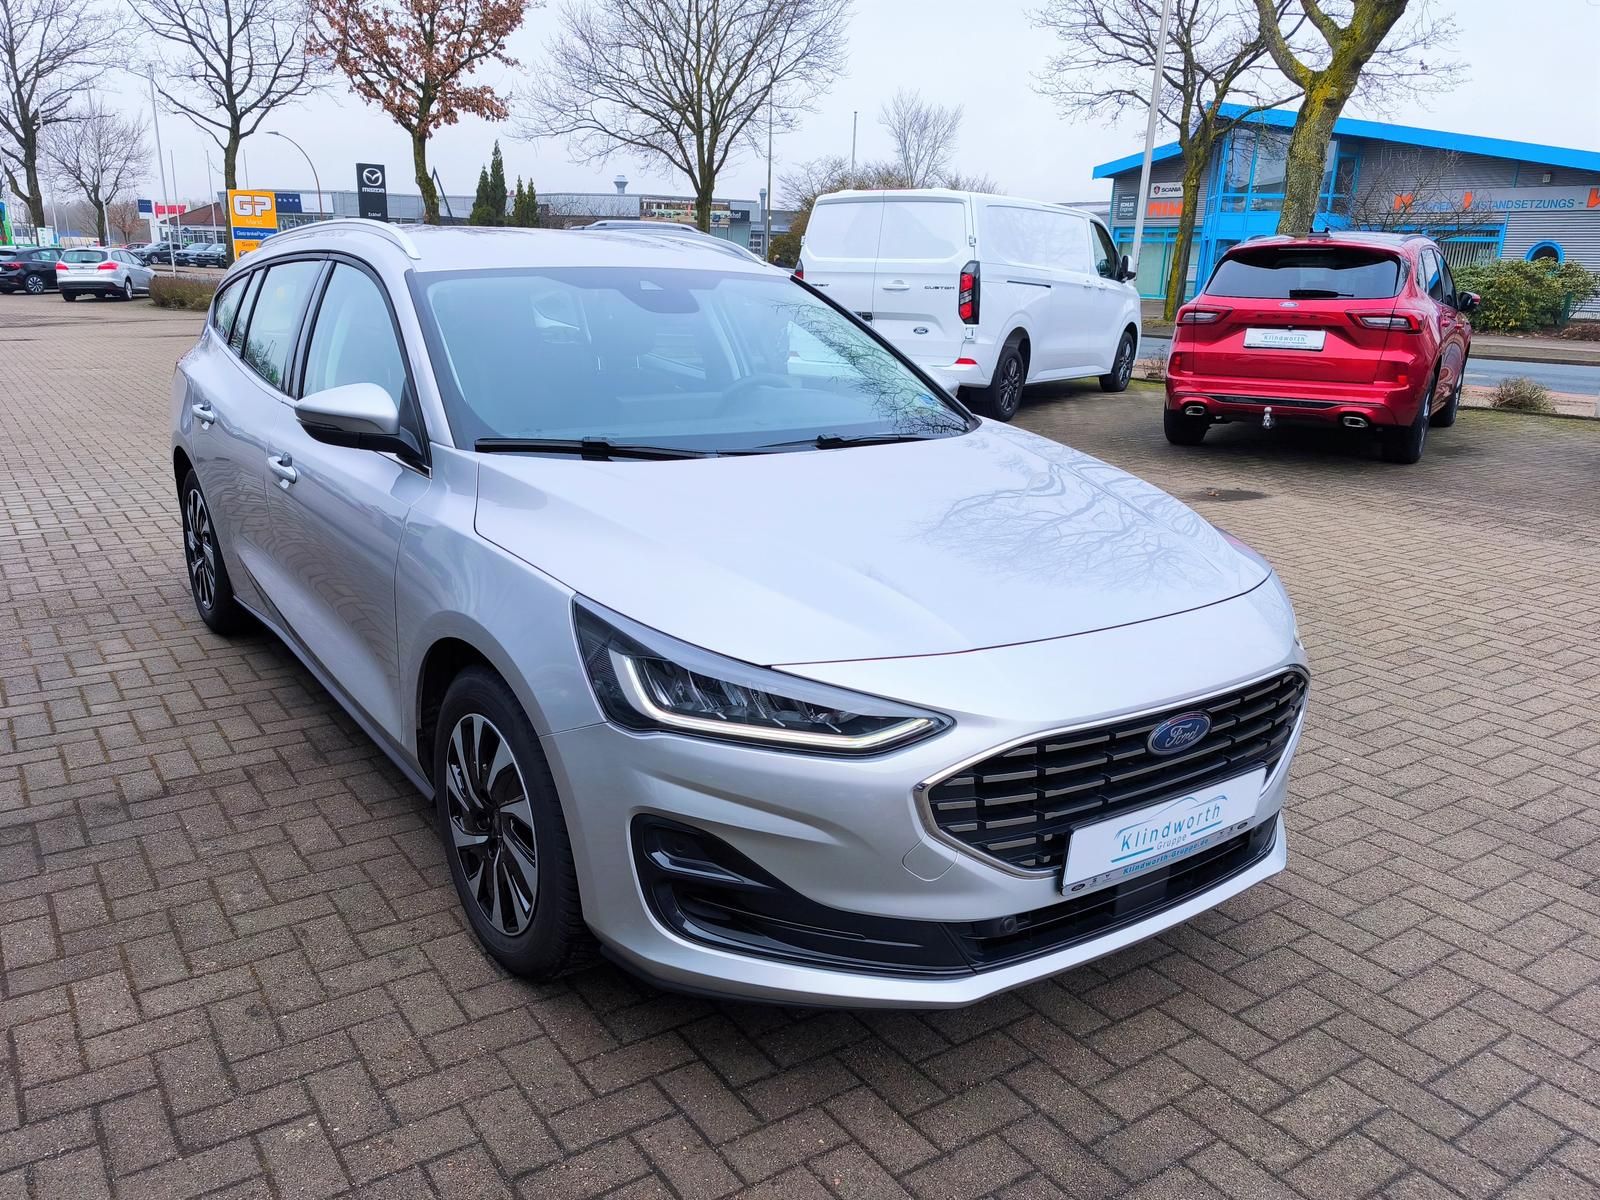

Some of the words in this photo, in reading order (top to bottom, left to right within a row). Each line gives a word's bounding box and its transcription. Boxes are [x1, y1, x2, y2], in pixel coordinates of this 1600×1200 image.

[233, 195, 272, 217] GP
[1165, 723, 1200, 748] Ford
[1121, 803, 1221, 851] Klindworth
[1156, 834, 1187, 851] Gruppe
[1122, 838, 1209, 875] Klindworth-Gruppe.de
